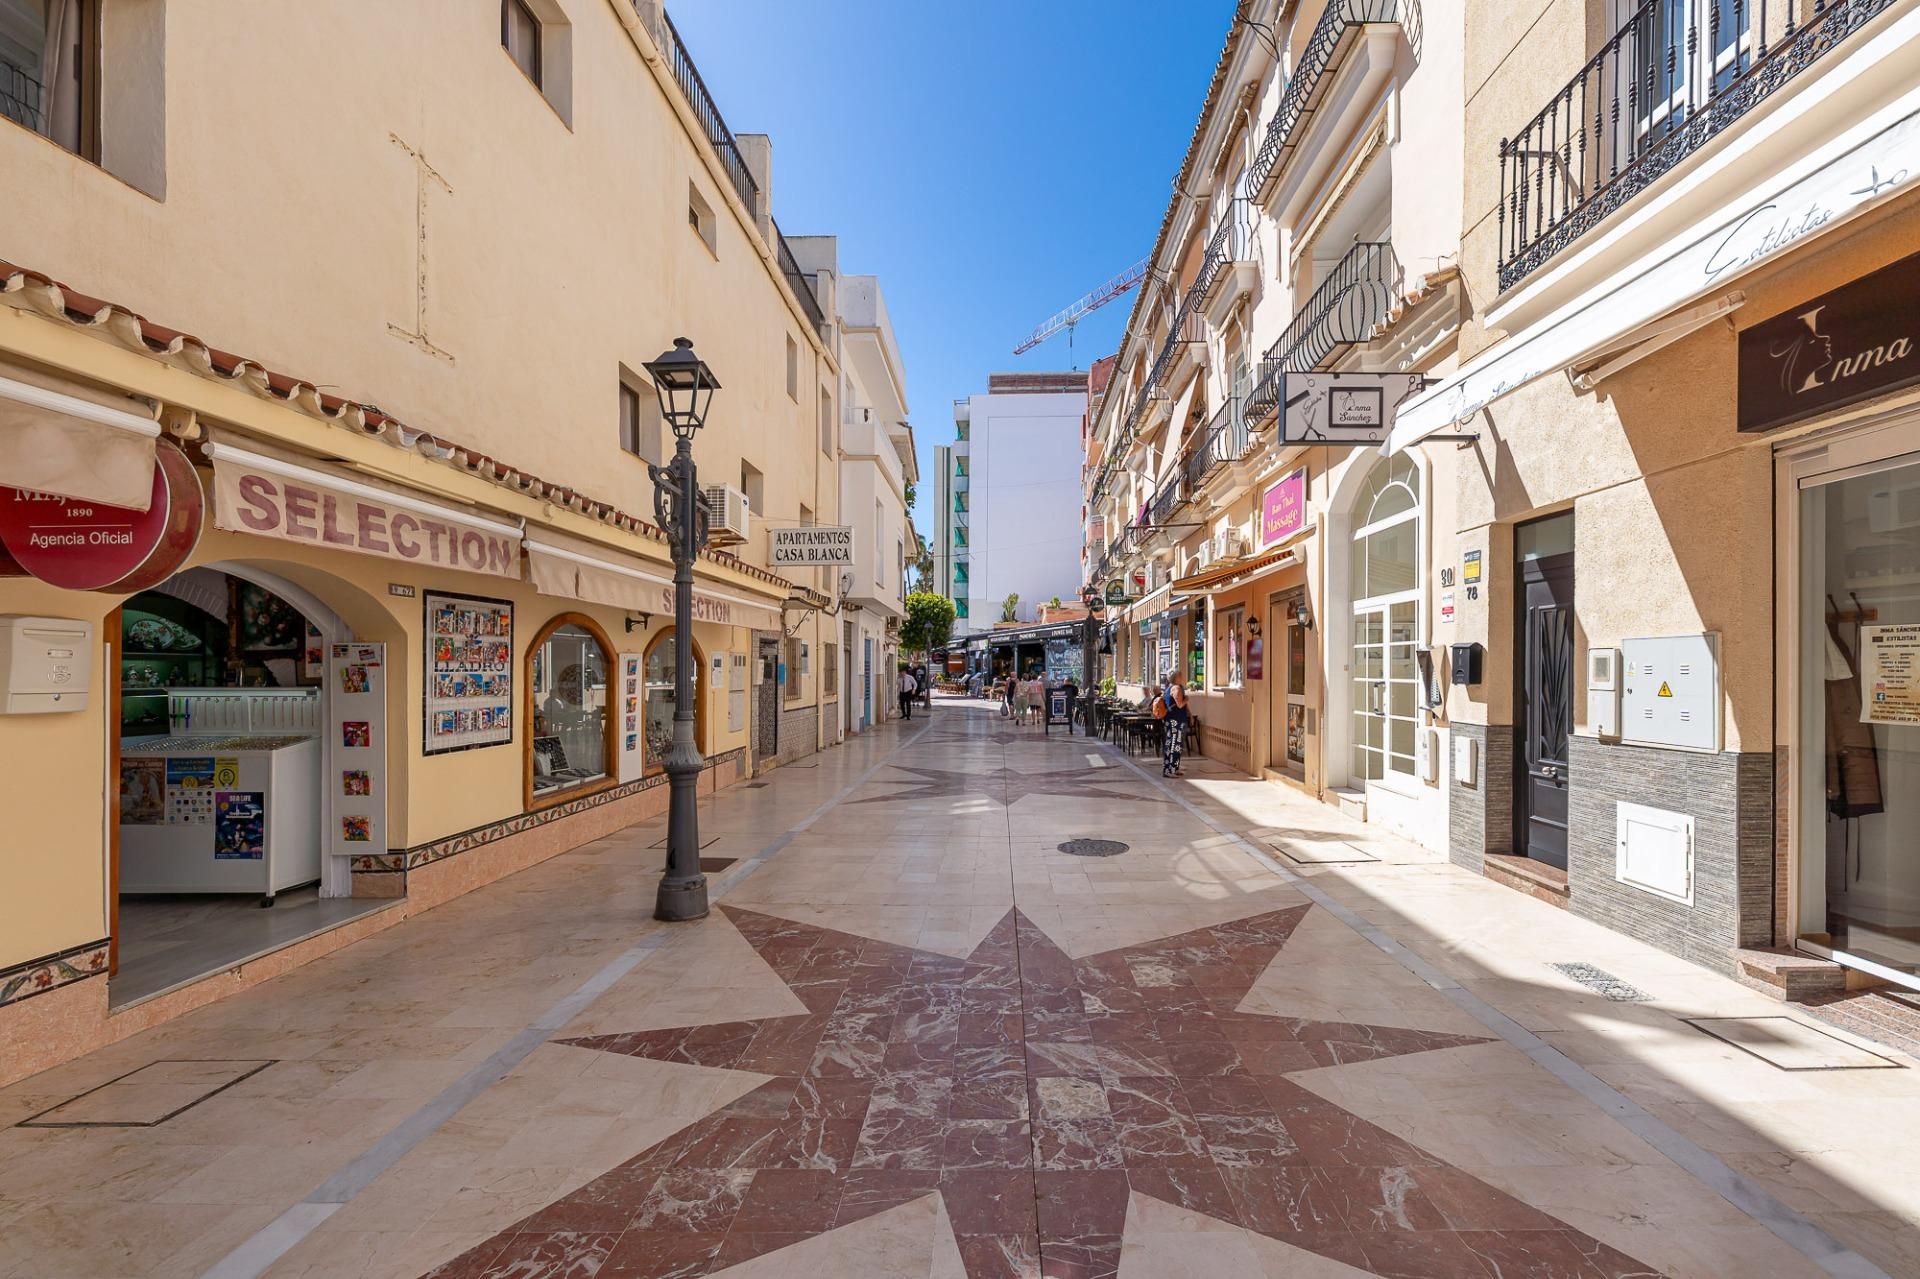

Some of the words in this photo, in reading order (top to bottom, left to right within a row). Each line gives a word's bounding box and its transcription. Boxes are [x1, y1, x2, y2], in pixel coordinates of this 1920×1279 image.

[66, 508, 93, 517] 1890
[237, 474, 512, 575] SELECTION
[1267, 508, 1298, 534] Massage
[30, 532, 86, 548] Agencia
[89, 531, 133, 545] Oficial
[776, 531, 850, 545] APARTAMENTOS
[776, 548, 804, 562] CASA
[808, 548, 850, 562] BLANCA
[1466, 586, 1478, 600] 78
